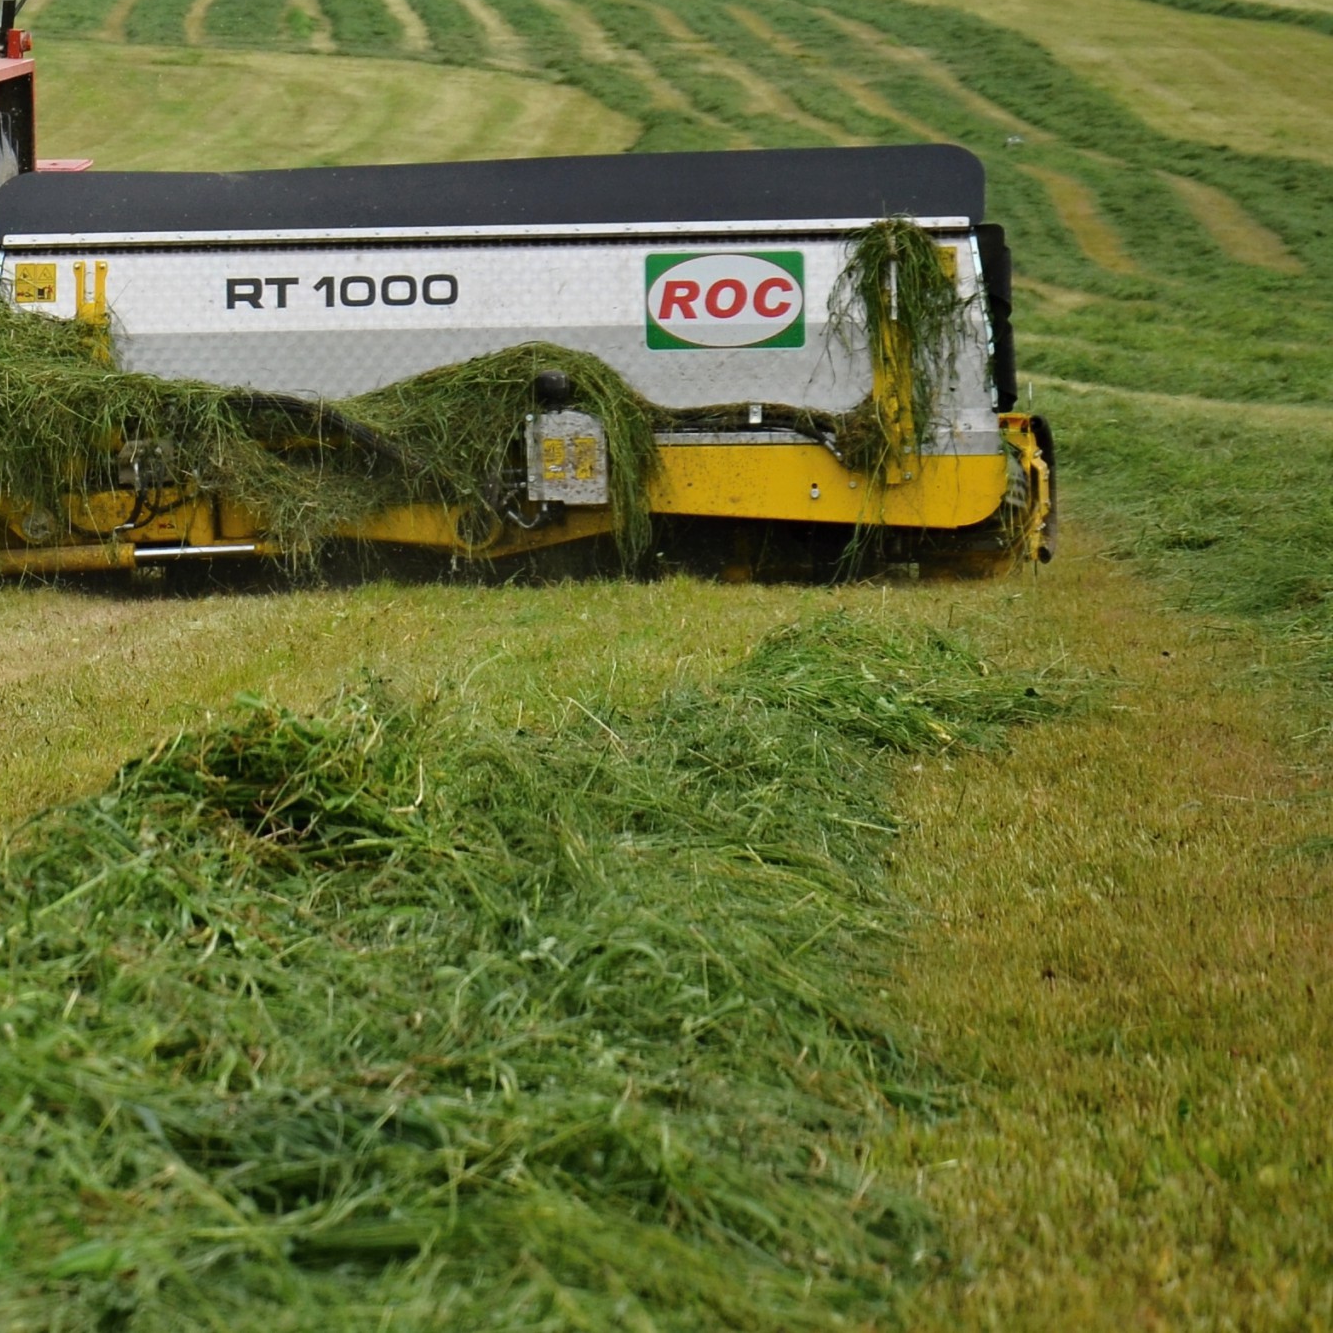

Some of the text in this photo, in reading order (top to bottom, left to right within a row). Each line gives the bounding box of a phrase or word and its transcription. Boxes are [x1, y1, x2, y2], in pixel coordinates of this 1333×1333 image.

[226, 274, 458, 310] RT 1000
[658, 277, 793, 319] ROC
